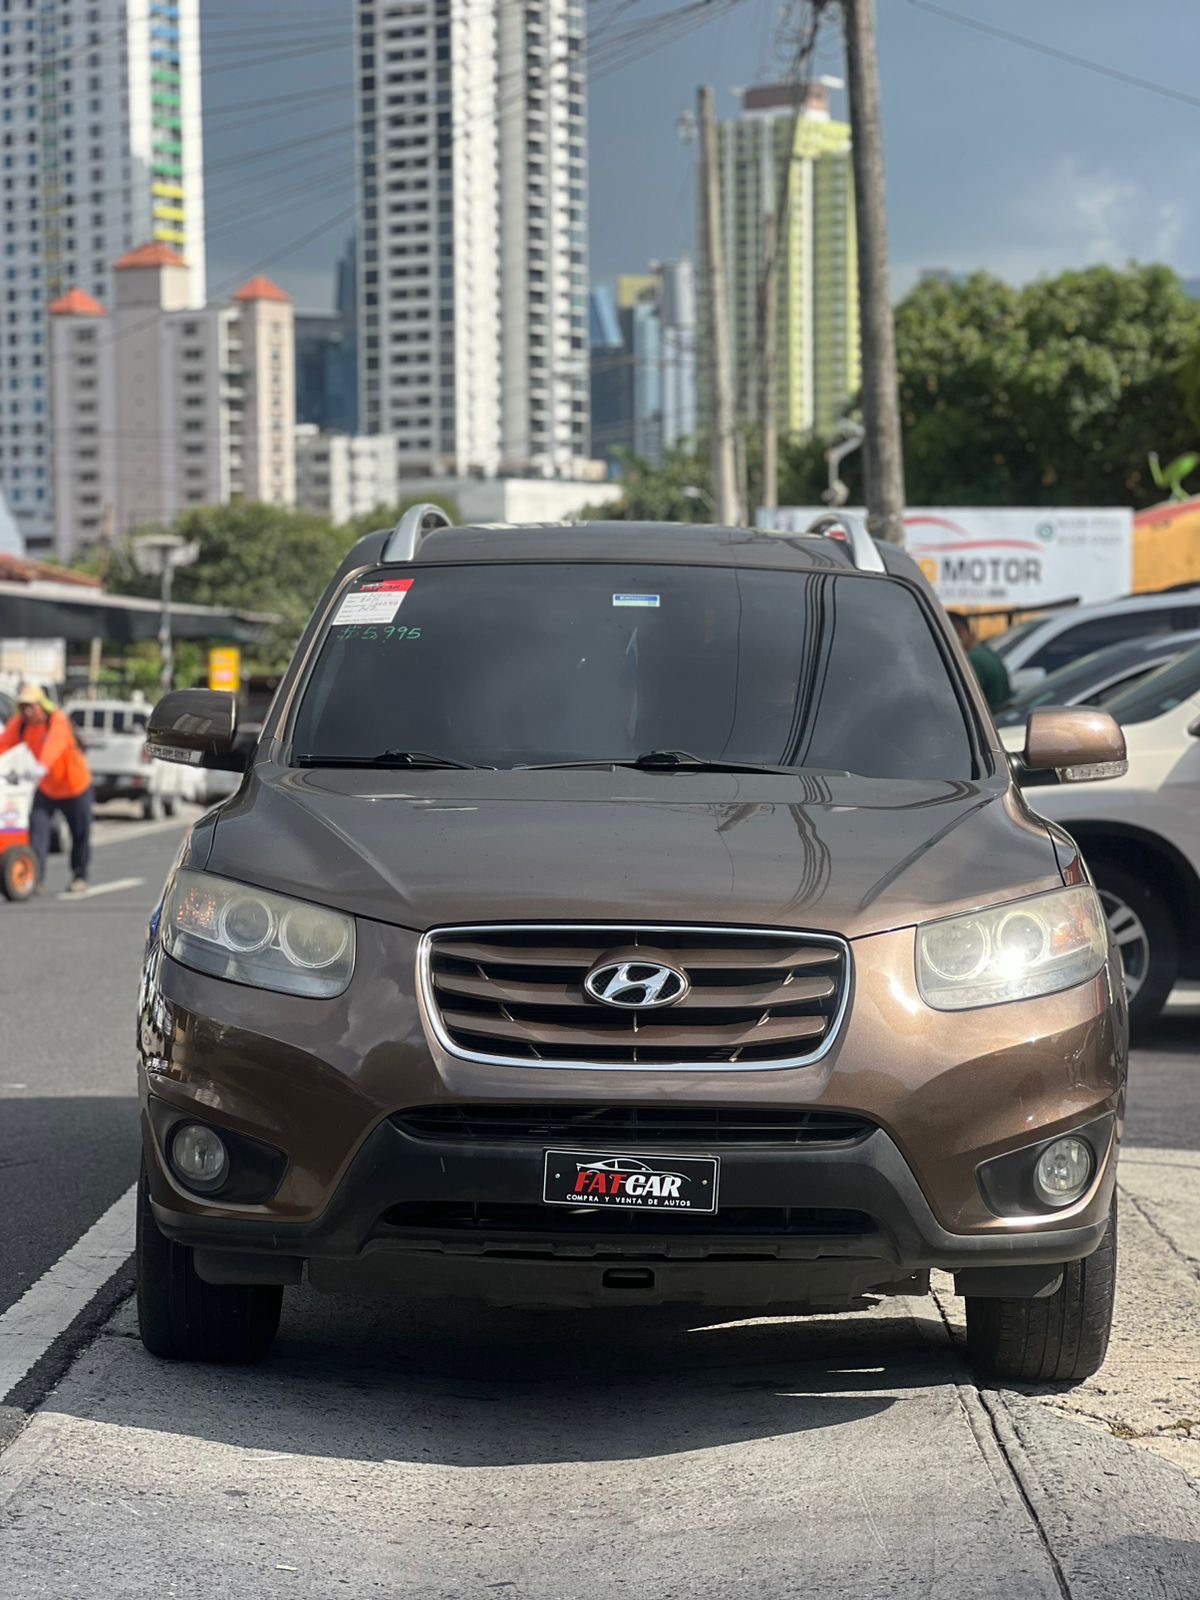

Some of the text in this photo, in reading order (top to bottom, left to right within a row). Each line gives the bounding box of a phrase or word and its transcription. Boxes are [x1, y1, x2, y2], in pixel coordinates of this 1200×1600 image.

[942, 557, 1041, 585] MOTOR
[574, 1171, 682, 1198] FATCAR
[566, 1193, 599, 1203] COMPRA
[604, 1195, 610, 1203] Y
[615, 1197, 643, 1205] VENTA
[647, 1198, 659, 1206] DE
